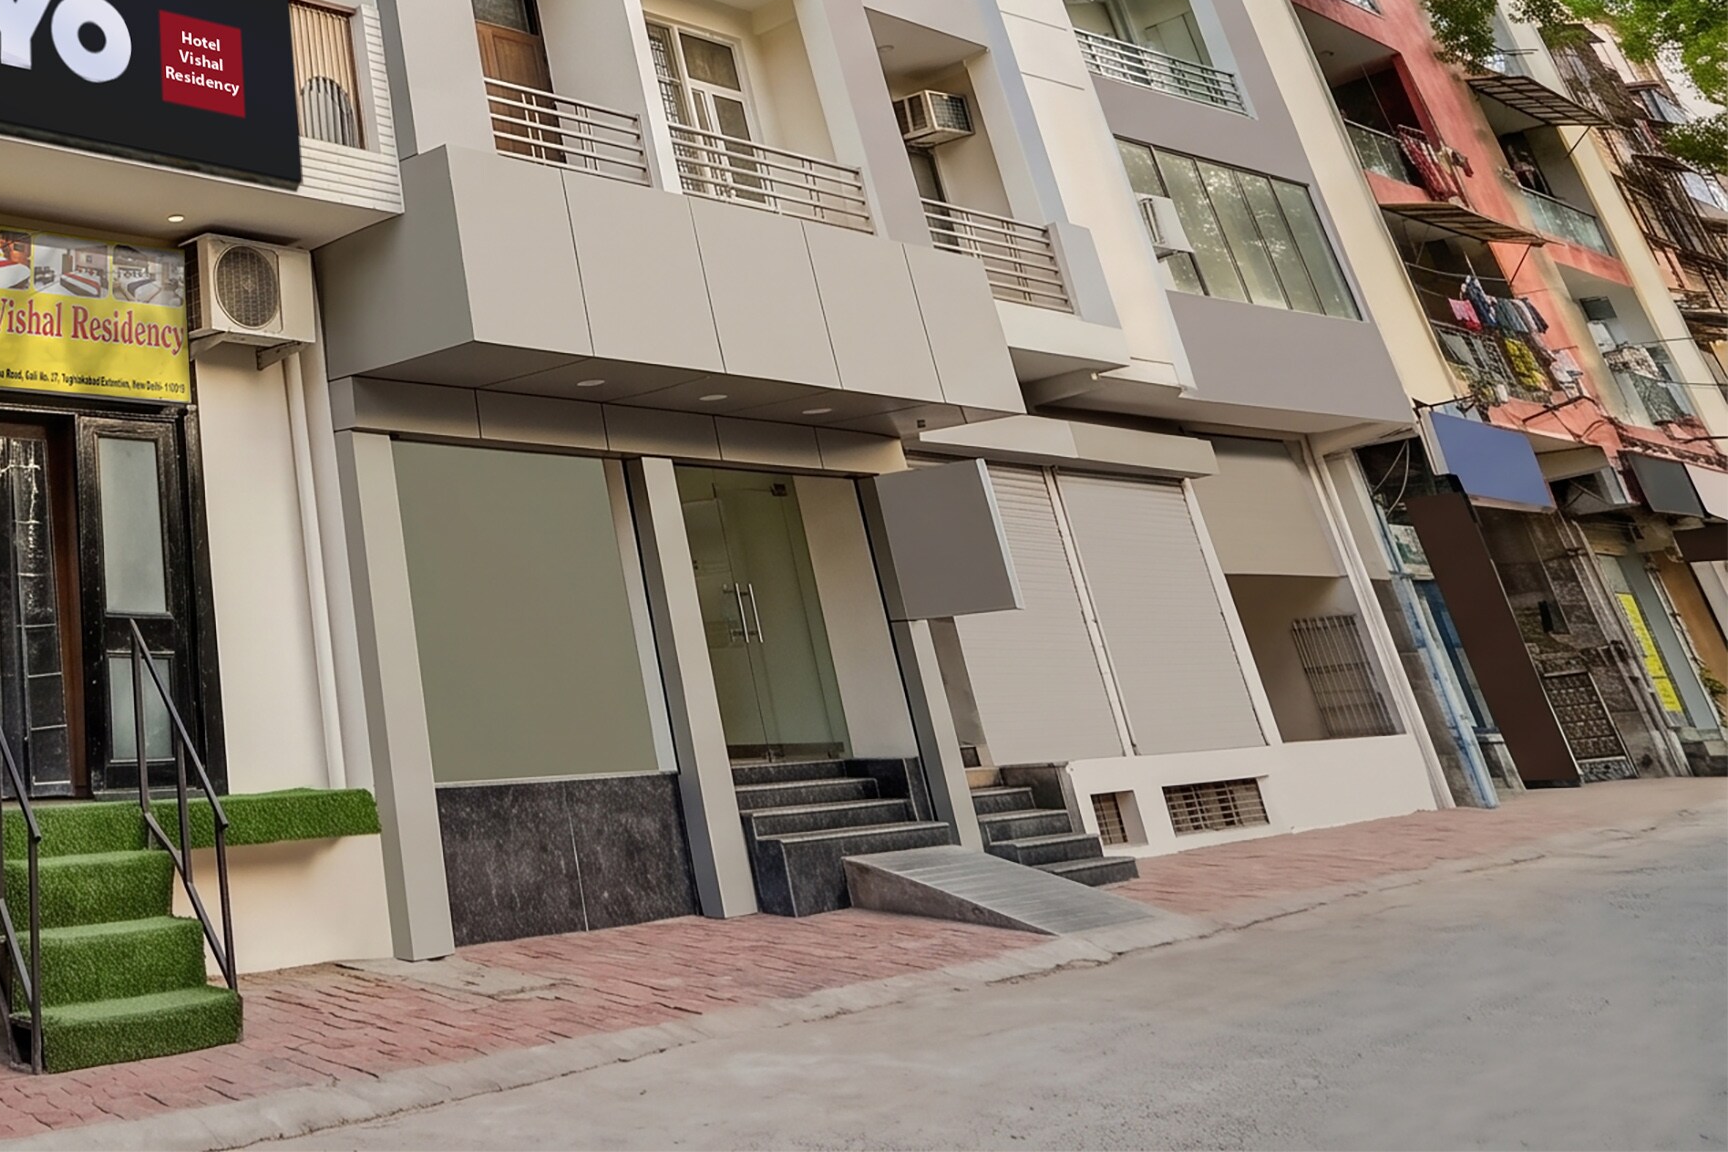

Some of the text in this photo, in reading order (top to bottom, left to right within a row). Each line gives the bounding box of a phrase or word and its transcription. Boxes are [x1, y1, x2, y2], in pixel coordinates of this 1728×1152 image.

[181, 30, 221, 52] Hotel
[178, 49, 224, 71] Vishal
[165, 65, 240, 97] Residency
[71, 304, 185, 356] Residency
